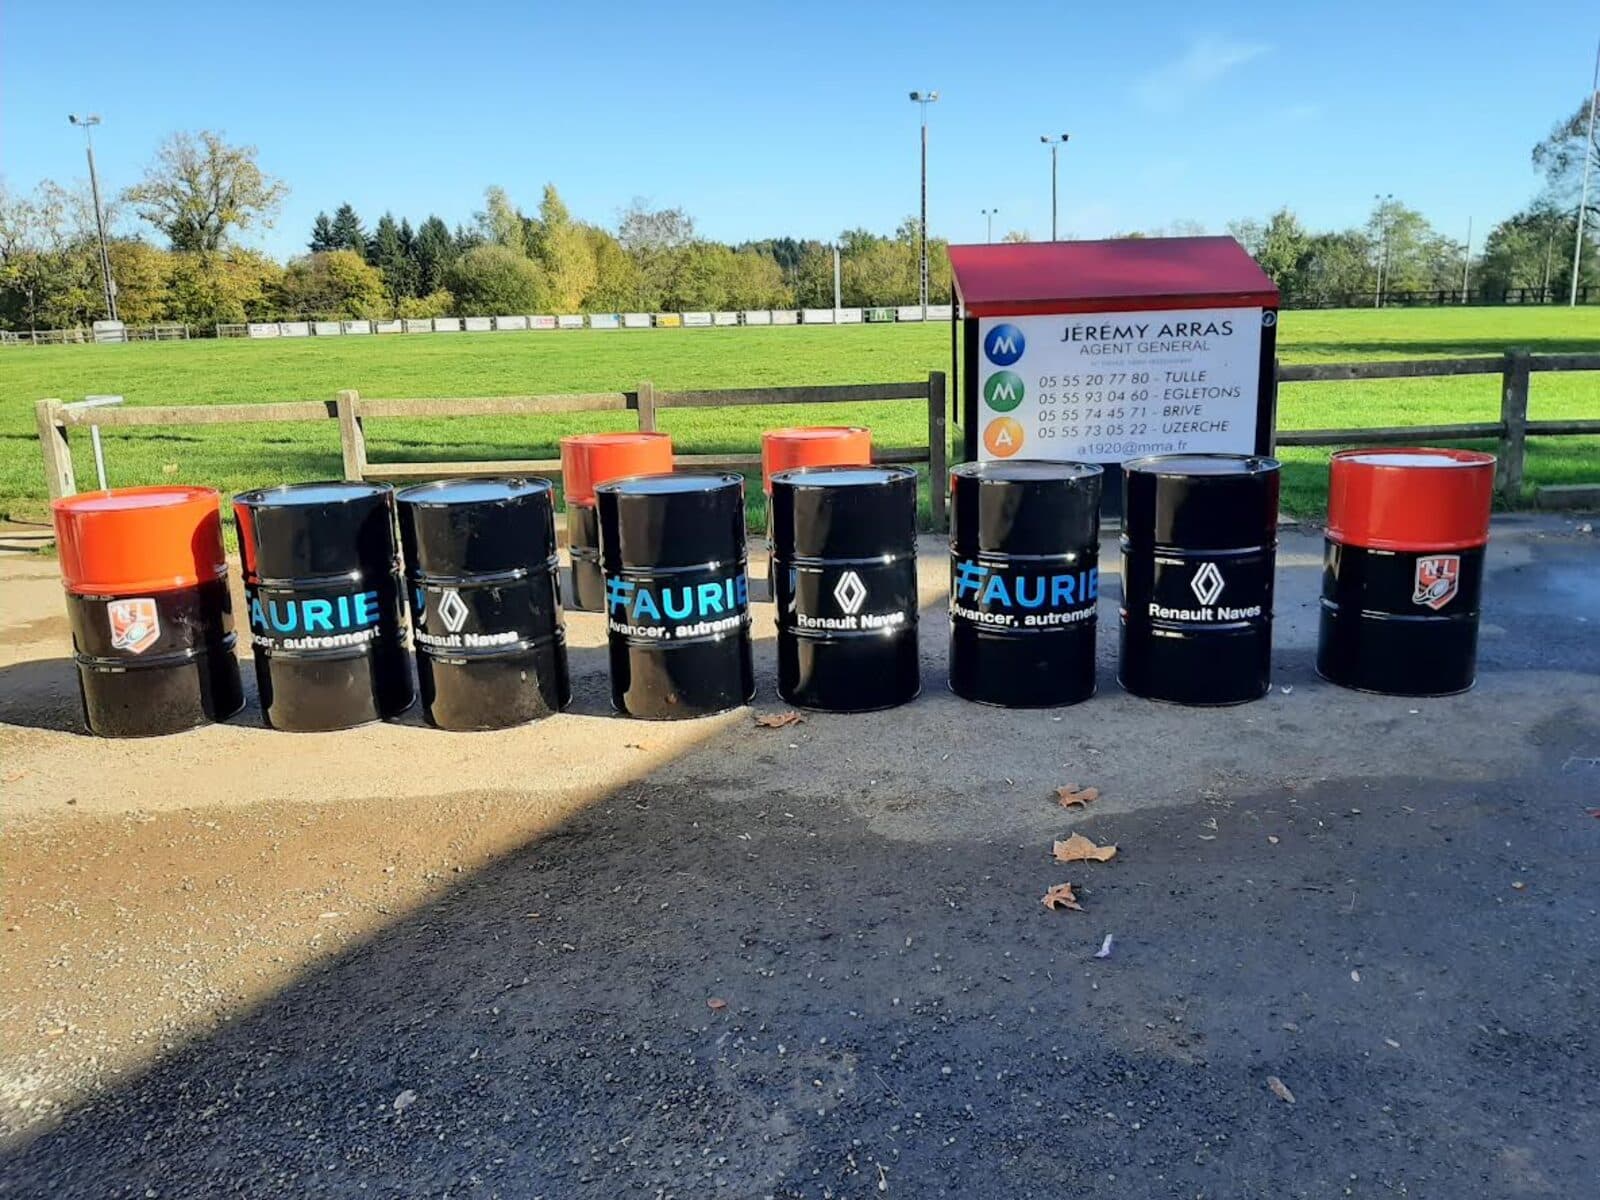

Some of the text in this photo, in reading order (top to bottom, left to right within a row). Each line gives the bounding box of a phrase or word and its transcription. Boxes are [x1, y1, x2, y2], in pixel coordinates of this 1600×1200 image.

[1060, 320, 1233, 342] JÉRÉMY ARRAS
[992, 335, 1017, 355] M
[1080, 342, 1132, 355] AGENT
[1039, 375, 1056, 388] 05
[1062, 374, 1080, 386] 55
[1086, 373, 1103, 386] 20
[1109, 373, 1126, 385] 77
[1131, 372, 1149, 384] 80
[1165, 370, 1207, 383] TULLE
[991, 383, 1016, 401] M
[1039, 393, 1056, 405] 05
[1062, 392, 1080, 404] 55
[1085, 391, 1102, 403] 93
[1107, 390, 1125, 402] 04
[1131, 389, 1149, 402] 60
[1163, 386, 1241, 401] EGLETONS
[1038, 410, 1055, 422] 05
[1061, 409, 1079, 421] 55
[1085, 408, 1102, 420] 74
[1107, 408, 1125, 419] 45
[1131, 407, 1146, 417] 71
[1163, 404, 1203, 417] BRIVE
[995, 428, 1013, 447] A
[1038, 427, 1055, 439] 05
[1061, 426, 1079, 438] 55
[1084, 425, 1101, 437] 73
[1106, 424, 1124, 436] 05
[1129, 423, 1147, 435] 22
[1162, 421, 1230, 434] UZERCHE
[1078, 440, 1188, 456] a1920@mma.fr
[797, 611, 905, 629] Renault Naves
[1149, 603, 1261, 621] Renault Naves
[283, 624, 380, 649] autrement
[415, 628, 519, 647] Renault Naves
